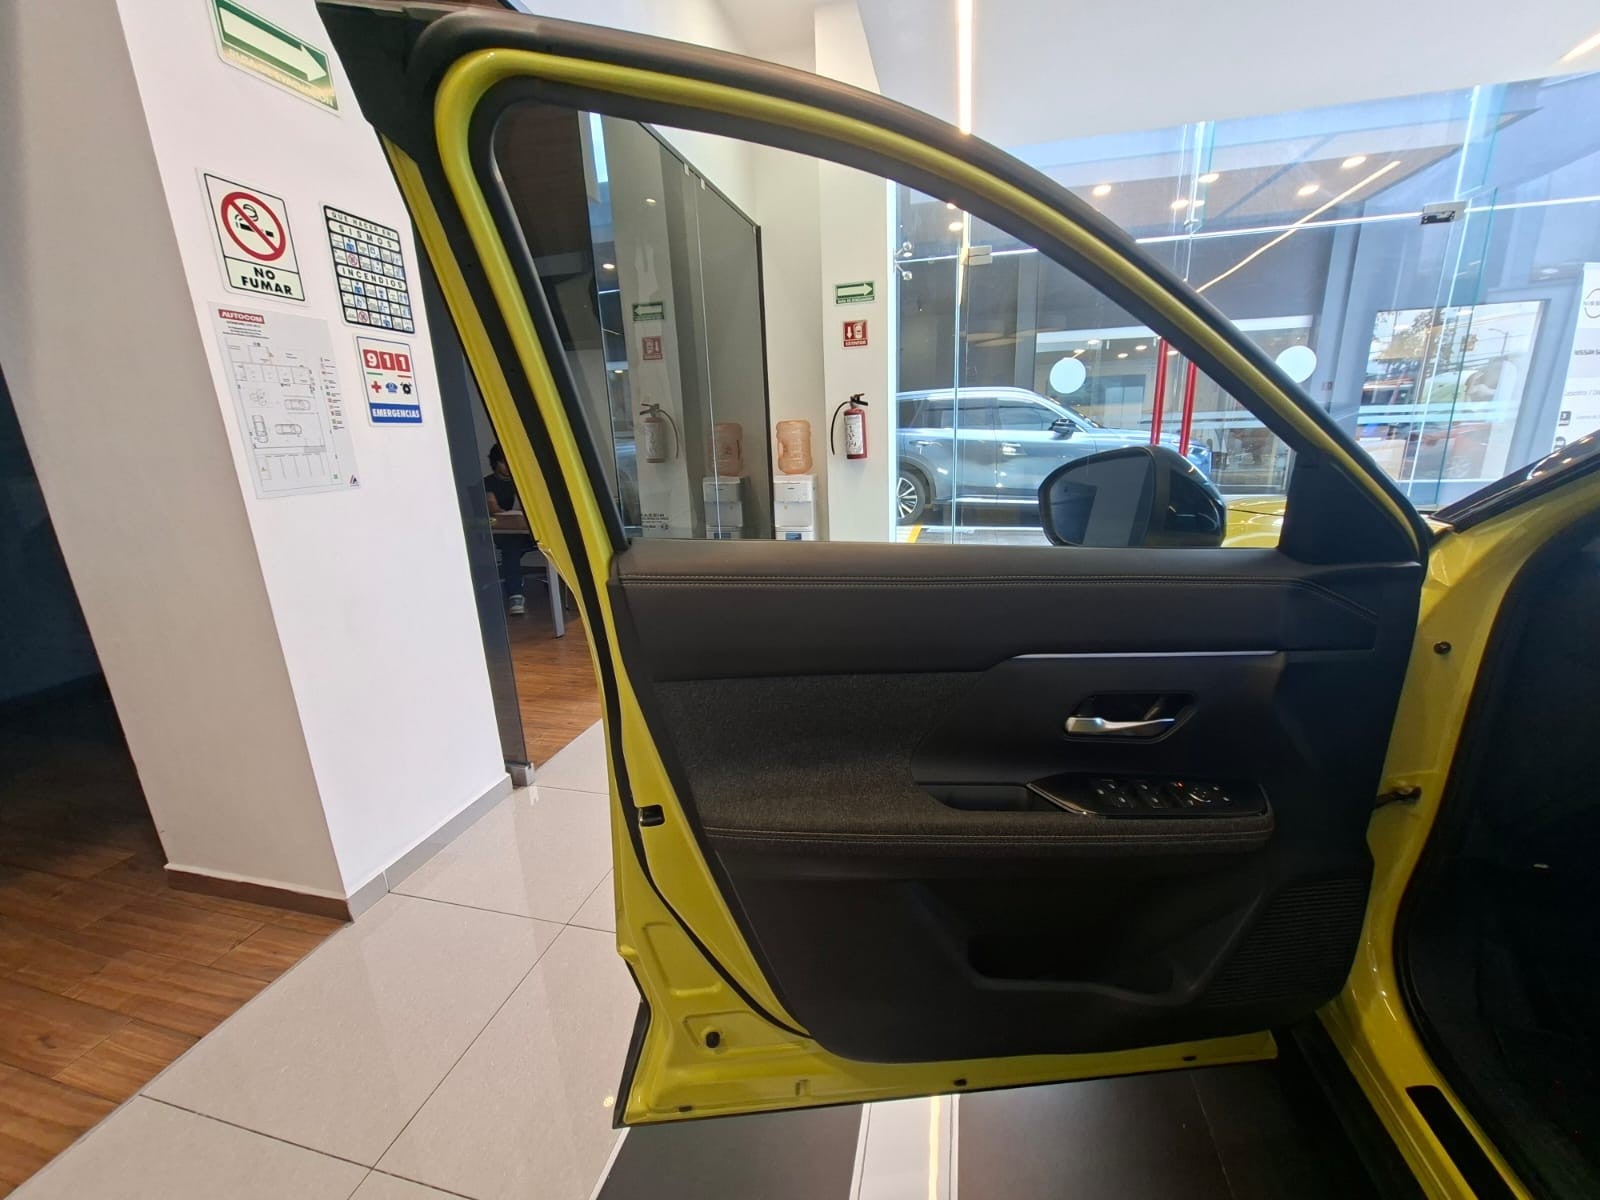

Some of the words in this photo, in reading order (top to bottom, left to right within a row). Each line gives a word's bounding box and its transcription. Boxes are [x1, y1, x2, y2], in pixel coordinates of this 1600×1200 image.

[338, 224, 392, 249] SISMOS
[253, 266, 276, 281] NO
[342, 267, 404, 289] INCENDIOS
[241, 275, 293, 296] FUMAR
[371, 408, 420, 419] EMERGENCIAS
